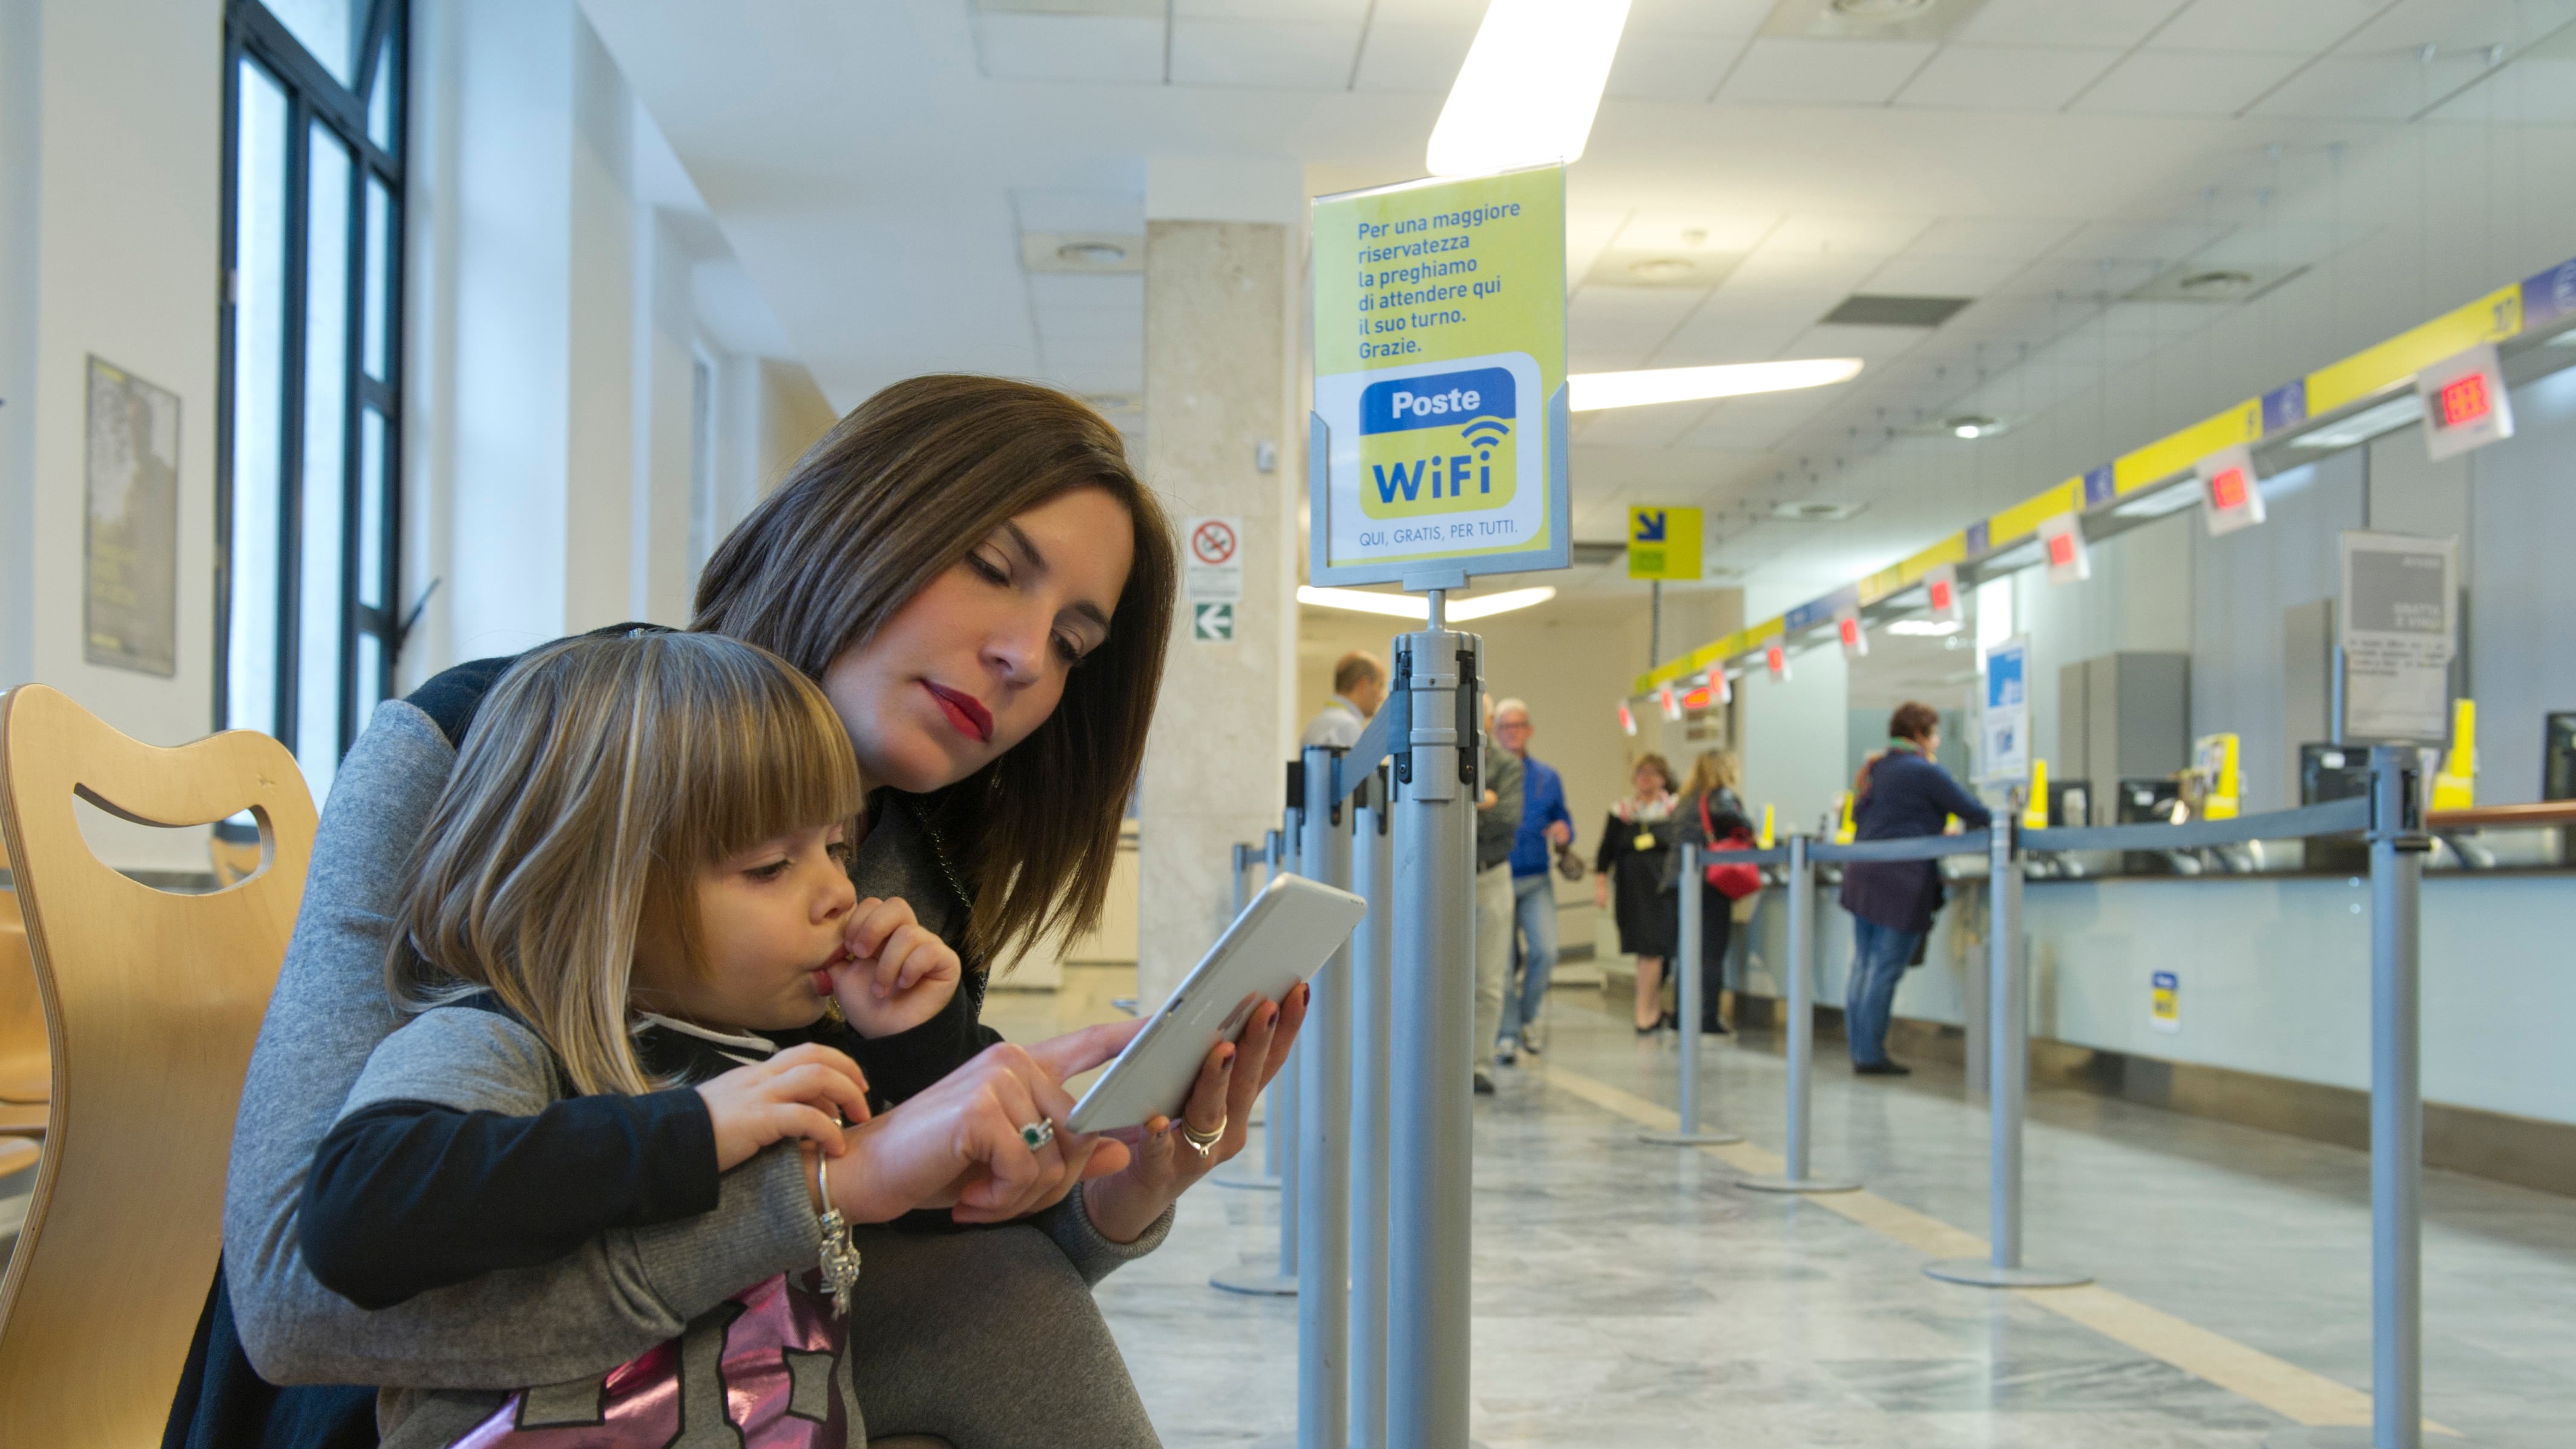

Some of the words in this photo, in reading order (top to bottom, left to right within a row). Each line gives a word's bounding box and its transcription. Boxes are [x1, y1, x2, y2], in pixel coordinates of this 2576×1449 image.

[1359, 222, 1390, 240] Per
[1395, 218, 1427, 235] una
[1433, 203, 1520, 228] maggiore
[1359, 235, 1470, 264] riservatezza
[1359, 271, 1374, 288] la
[1379, 258, 1477, 289] preghiamo
[1359, 294, 1374, 311] di
[1379, 283, 1467, 309] attendere
[1473, 275, 1501, 300] qui
[1359, 319, 1369, 335] il
[1375, 315, 1406, 334] suo
[1411, 309, 1467, 329] turno.
[1359, 337, 1422, 359] Grazie.
[1393, 388, 1480, 419] Poste
[1372, 450, 1490, 504] WiFi
[1359, 532, 1389, 547] QUI,
[1394, 527, 1445, 543] GRATIS,
[1450, 524, 1473, 538] PER
[1479, 519, 1518, 536] TUTTI.
